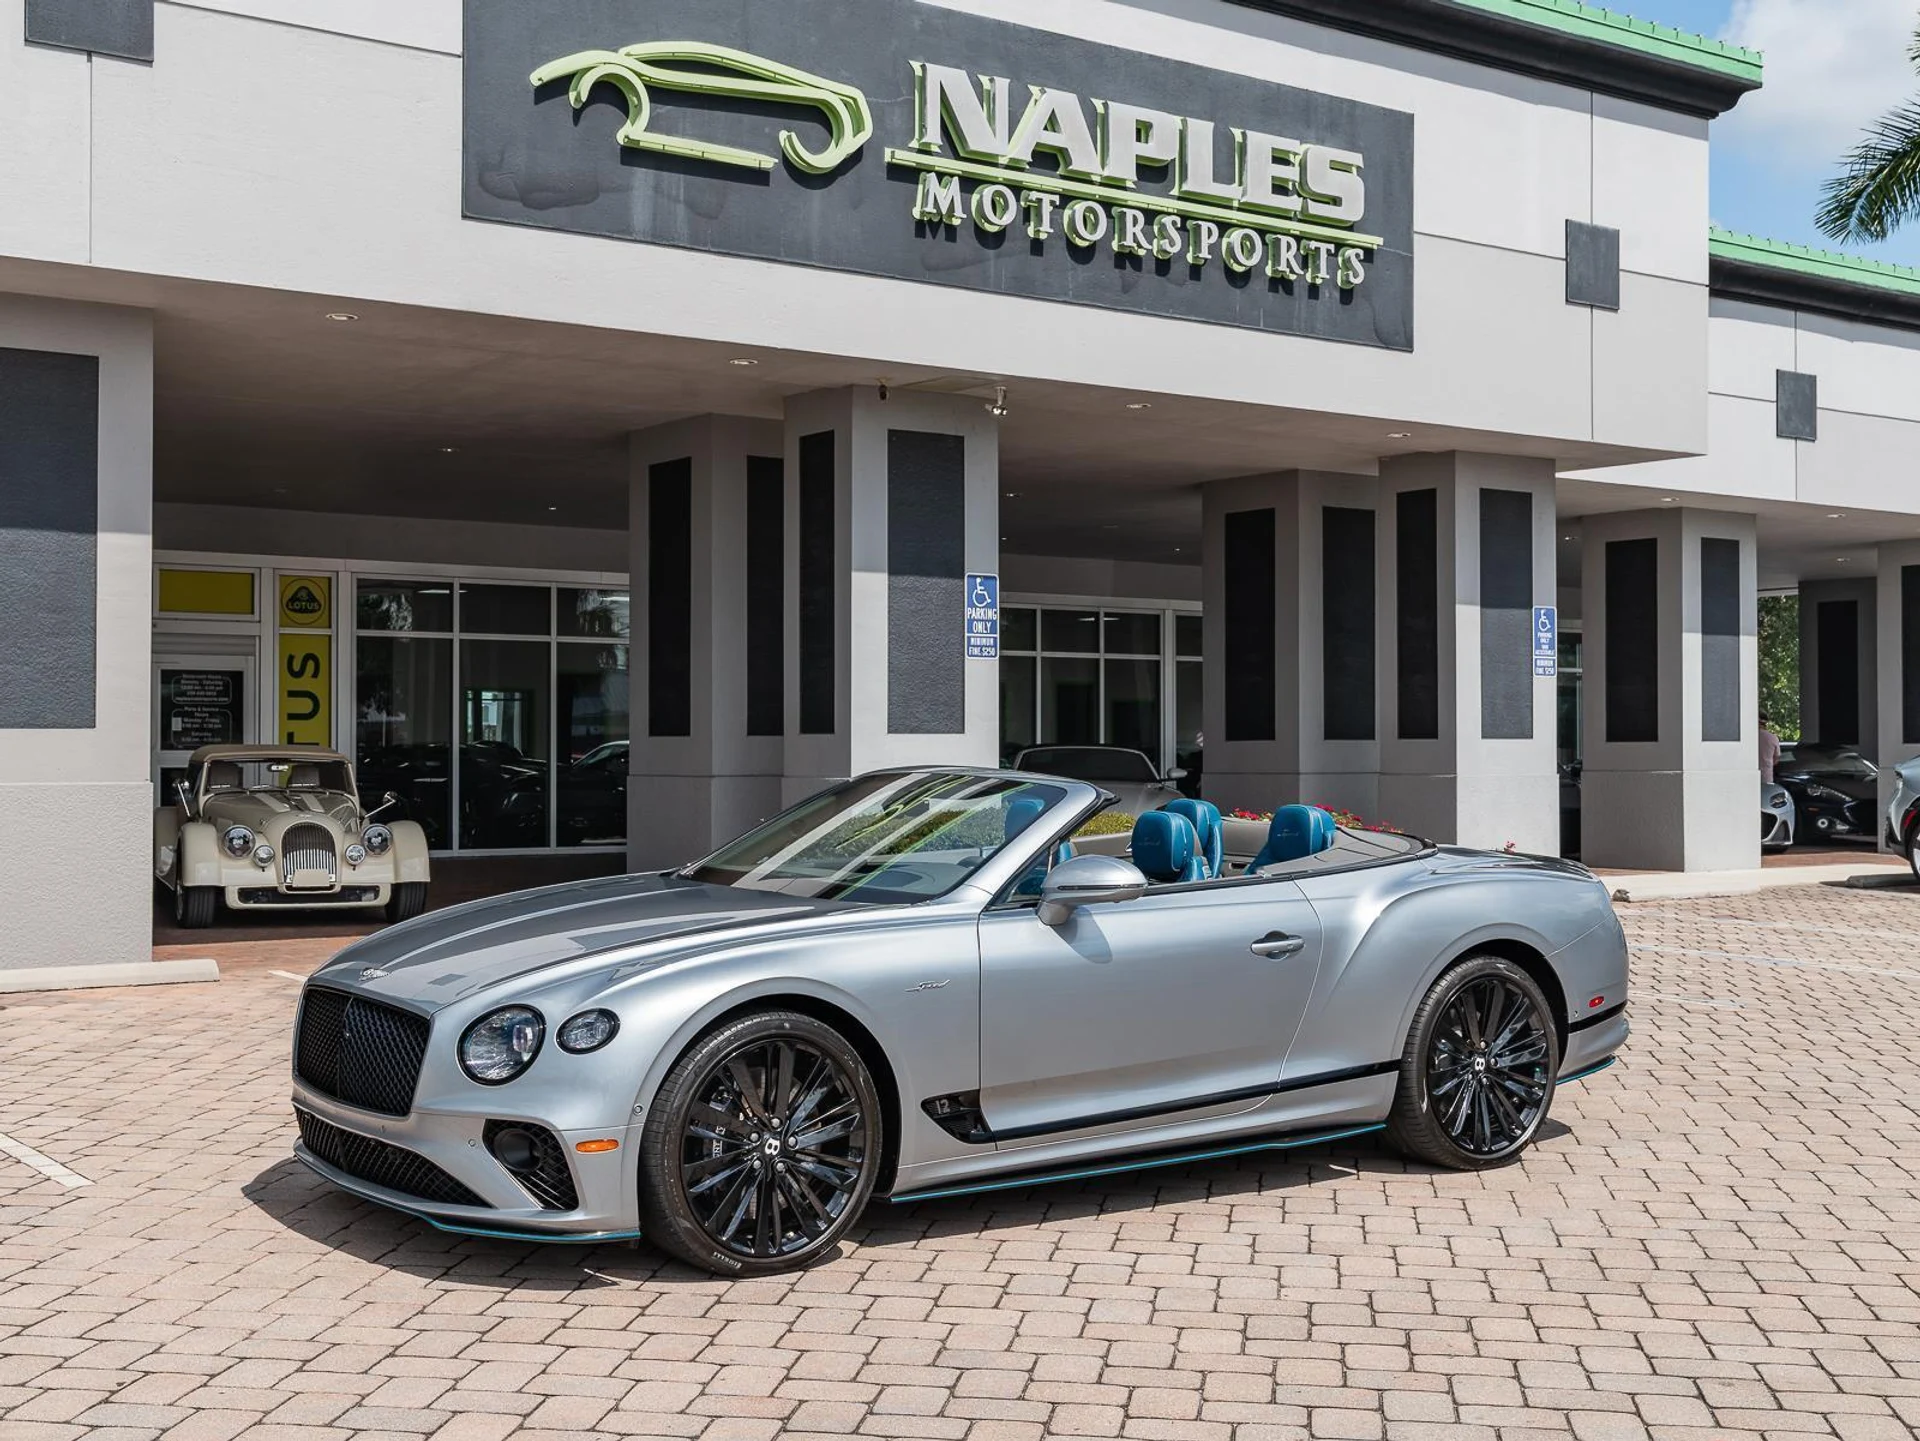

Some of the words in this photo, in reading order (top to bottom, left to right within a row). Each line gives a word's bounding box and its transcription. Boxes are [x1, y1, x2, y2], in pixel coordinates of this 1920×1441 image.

[908, 60, 1365, 225] NAPLES
[913, 172, 1366, 289] MOTORSPORTS
[288, 601, 320, 610] LOTUS
[968, 607, 996, 620] PARKING
[973, 621, 991, 633] ONLY
